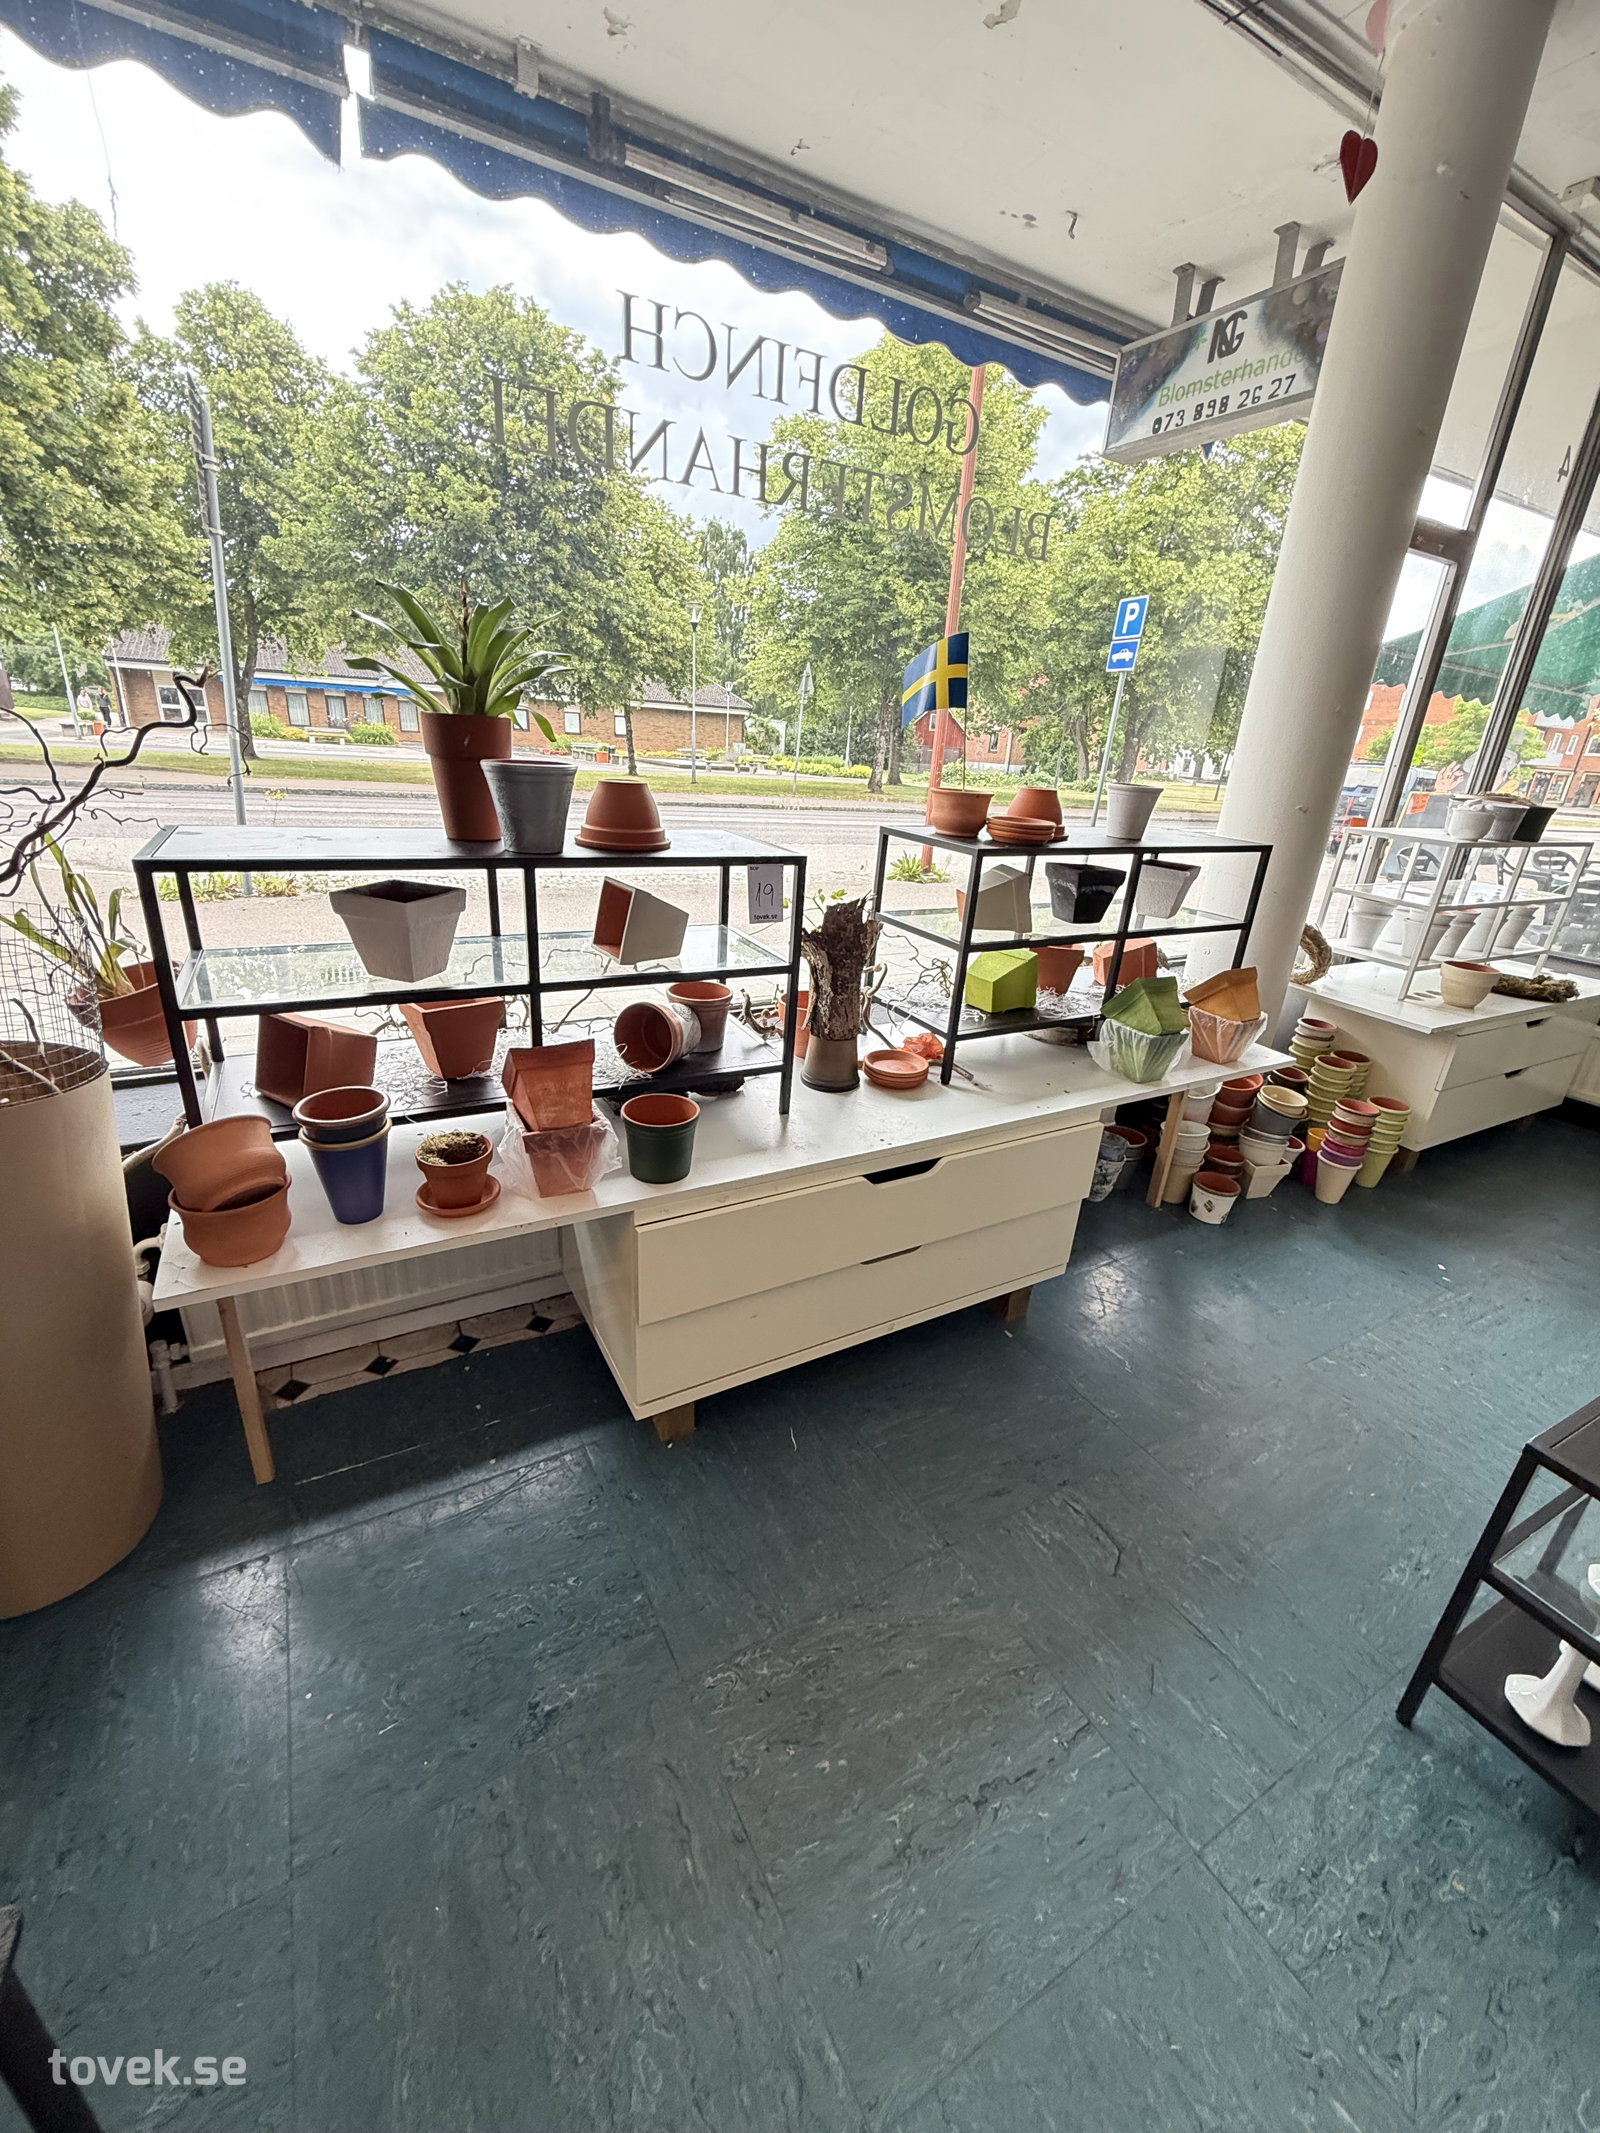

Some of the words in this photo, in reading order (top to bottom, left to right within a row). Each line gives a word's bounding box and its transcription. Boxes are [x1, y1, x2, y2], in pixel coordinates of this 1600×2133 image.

[1151, 409, 1185, 434] 073
[1193, 394, 1230, 422] 898
[1237, 384, 1263, 409] 26
[1267, 373, 1297, 400] 27
[1121, 602, 1140, 634] P
[755, 882, 774, 907] 19
